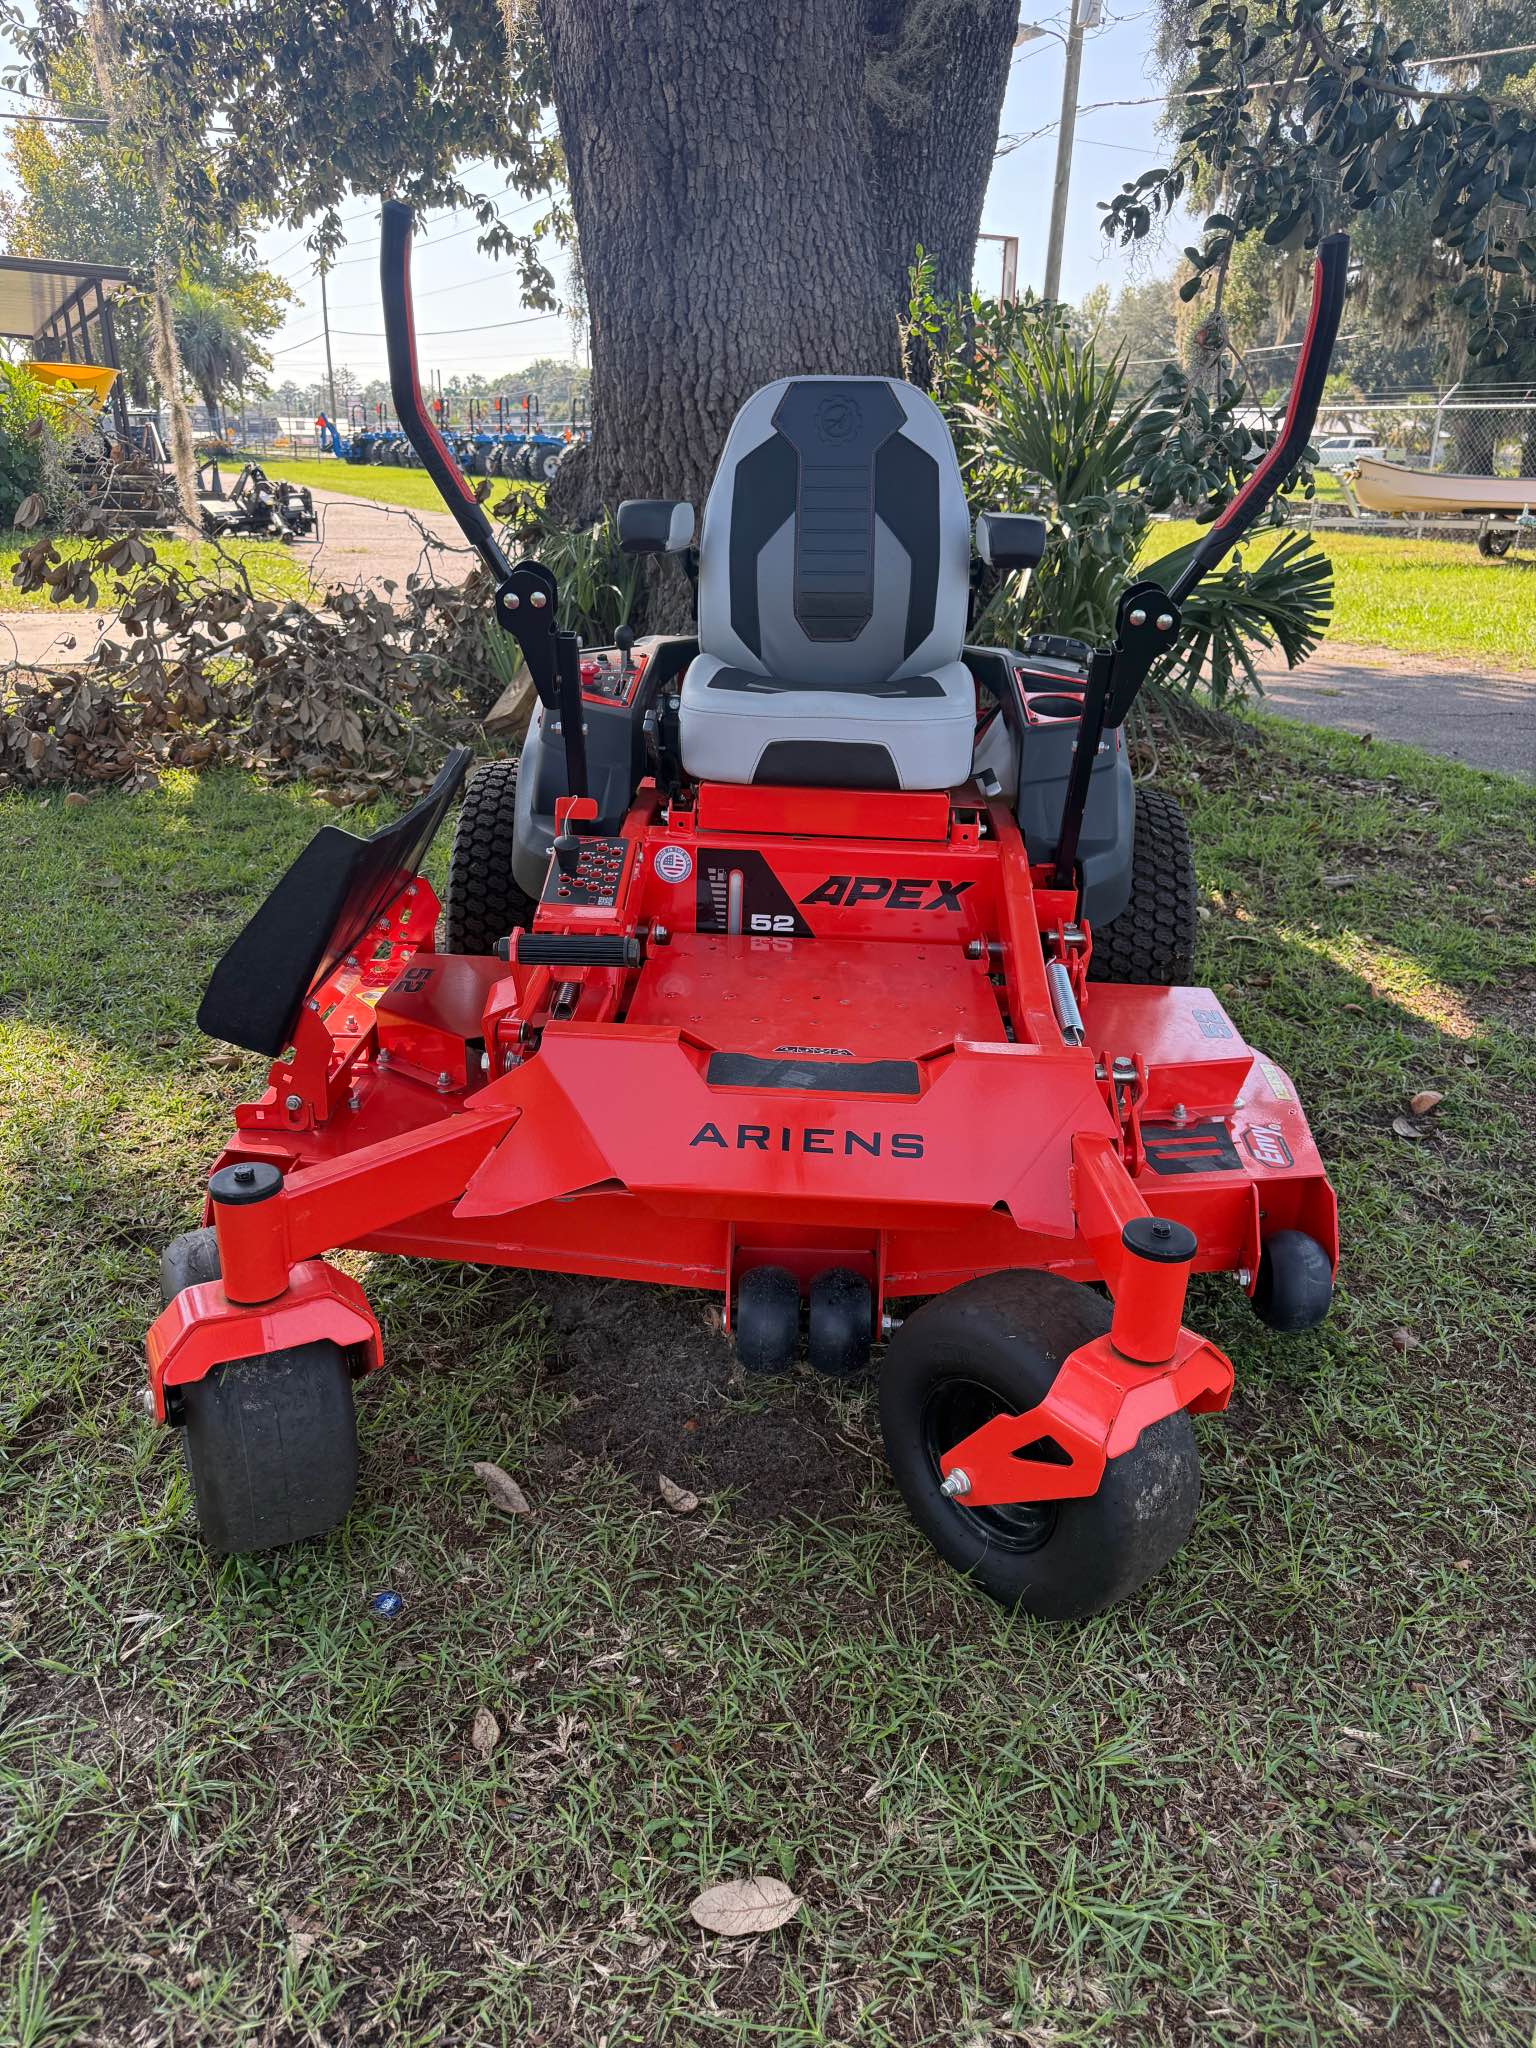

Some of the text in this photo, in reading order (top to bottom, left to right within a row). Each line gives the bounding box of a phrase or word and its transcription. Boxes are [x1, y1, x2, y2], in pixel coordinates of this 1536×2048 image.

[799, 876, 976, 912] APEX
[751, 914, 794, 932] 52
[392, 967, 435, 993] 52
[1192, 1009, 1233, 1039] 52
[689, 1122, 924, 1158] ARIENS
